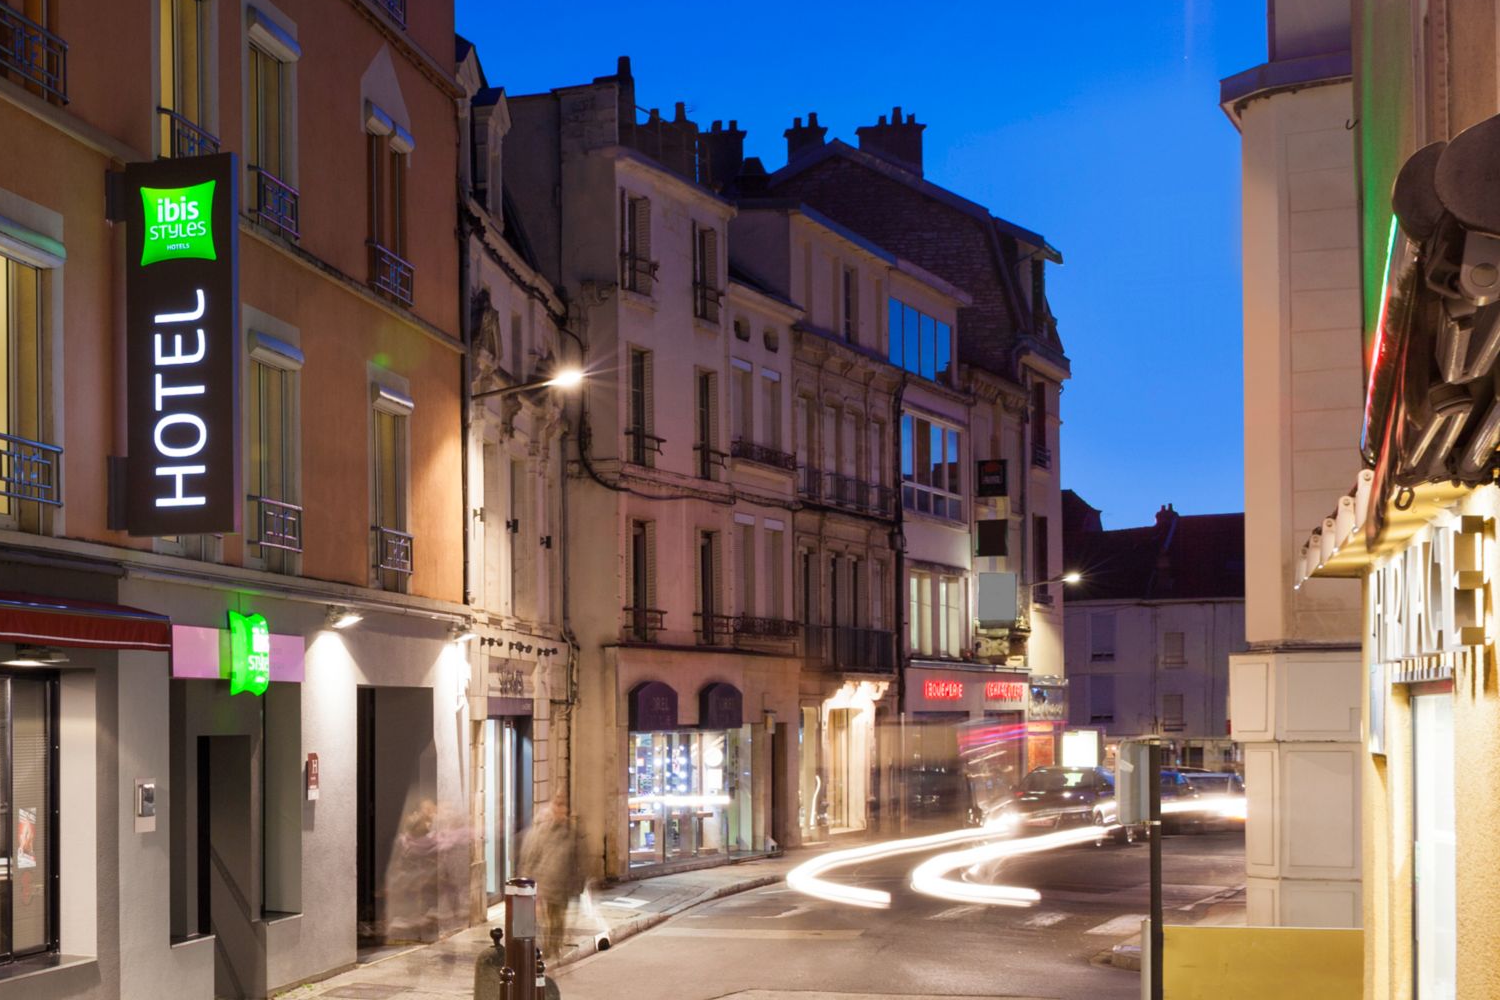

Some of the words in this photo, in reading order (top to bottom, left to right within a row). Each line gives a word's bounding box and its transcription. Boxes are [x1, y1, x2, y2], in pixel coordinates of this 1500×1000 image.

[157, 196, 199, 222] ibis
[166, 243, 190, 251] HOTELS
[154, 289, 206, 506] HOTEL
